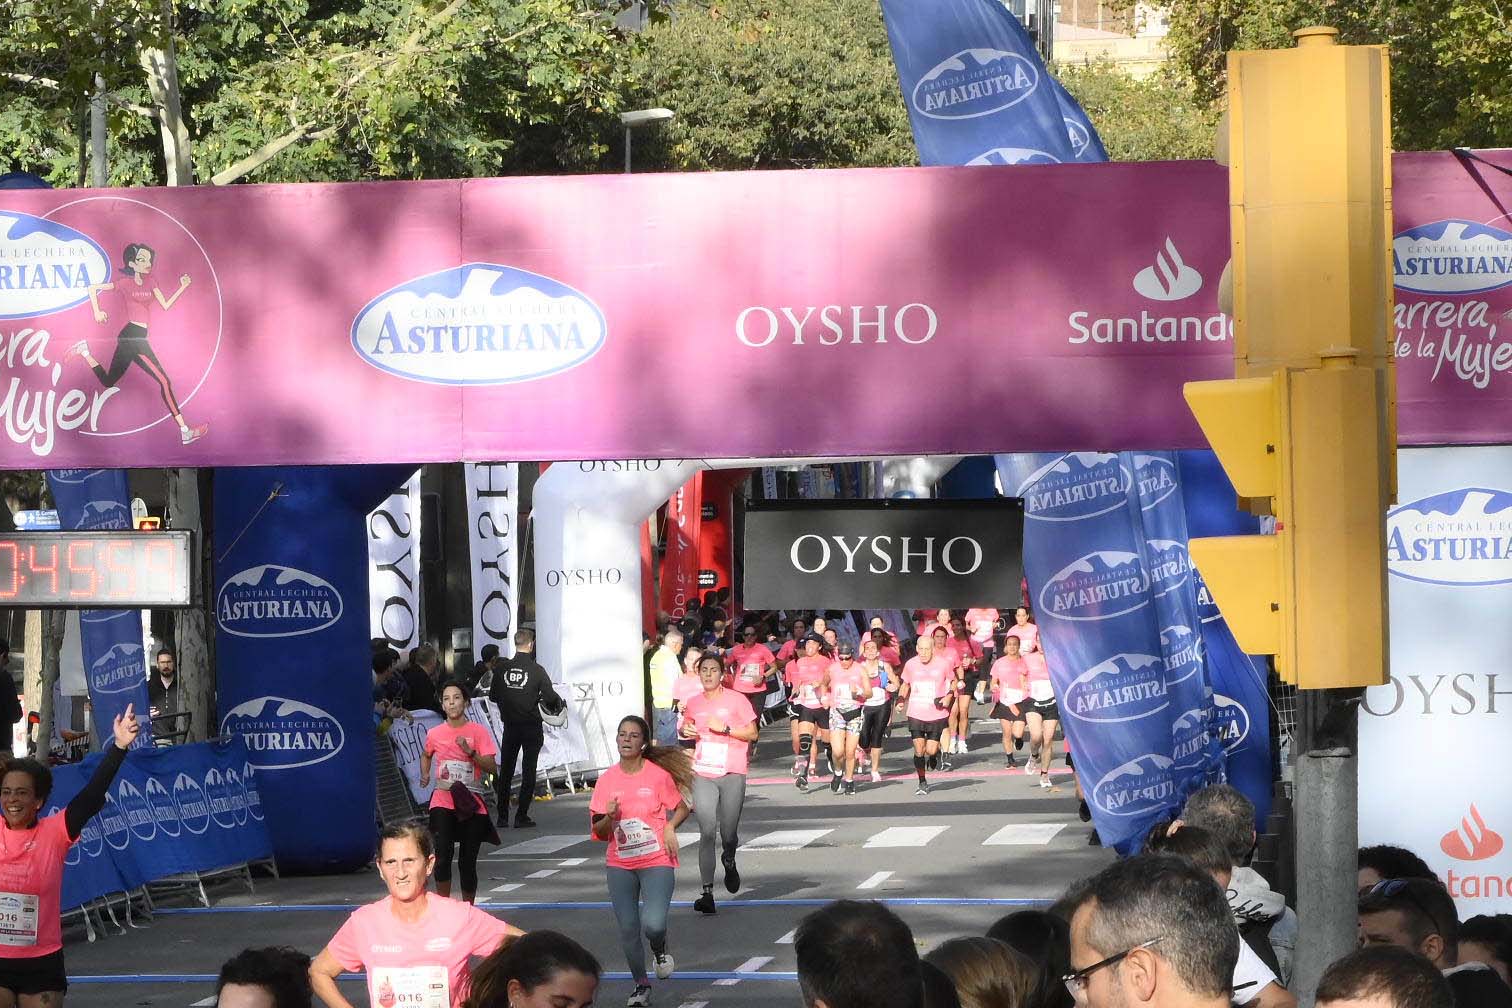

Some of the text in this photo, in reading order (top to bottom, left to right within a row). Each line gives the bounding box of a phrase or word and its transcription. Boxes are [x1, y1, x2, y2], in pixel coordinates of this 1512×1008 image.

[13, 247, 85, 258] LECHERA
[1408, 244, 1512, 253] CENTRAL LECHER
[735, 303, 938, 347] OYSHO
[1394, 301, 1489, 329] arrera
[371, 312, 586, 355] ASTURIANA
[1068, 311, 1233, 343] Santand
[1417, 330, 1434, 358] la
[1431, 324, 1512, 389] Muje
[579, 460, 661, 473] OYSHO
[1414, 521, 1482, 532] CENTRAL
[1387, 525, 1512, 562] ASTURI
[790, 534, 982, 576] OYSHO
[546, 567, 622, 588] OYSHO
[280, 590, 329, 598] LECHERA
[221, 597, 333, 621] ASTURIANA
[509, 673, 522, 682] BP
[576, 681, 623, 698] SHO
[1360, 673, 1512, 717] OYSH
[235, 721, 330, 730] CENTRAL LECHERA
[224, 725, 334, 750] TURIANA
[398, 993, 422, 1003] 016
